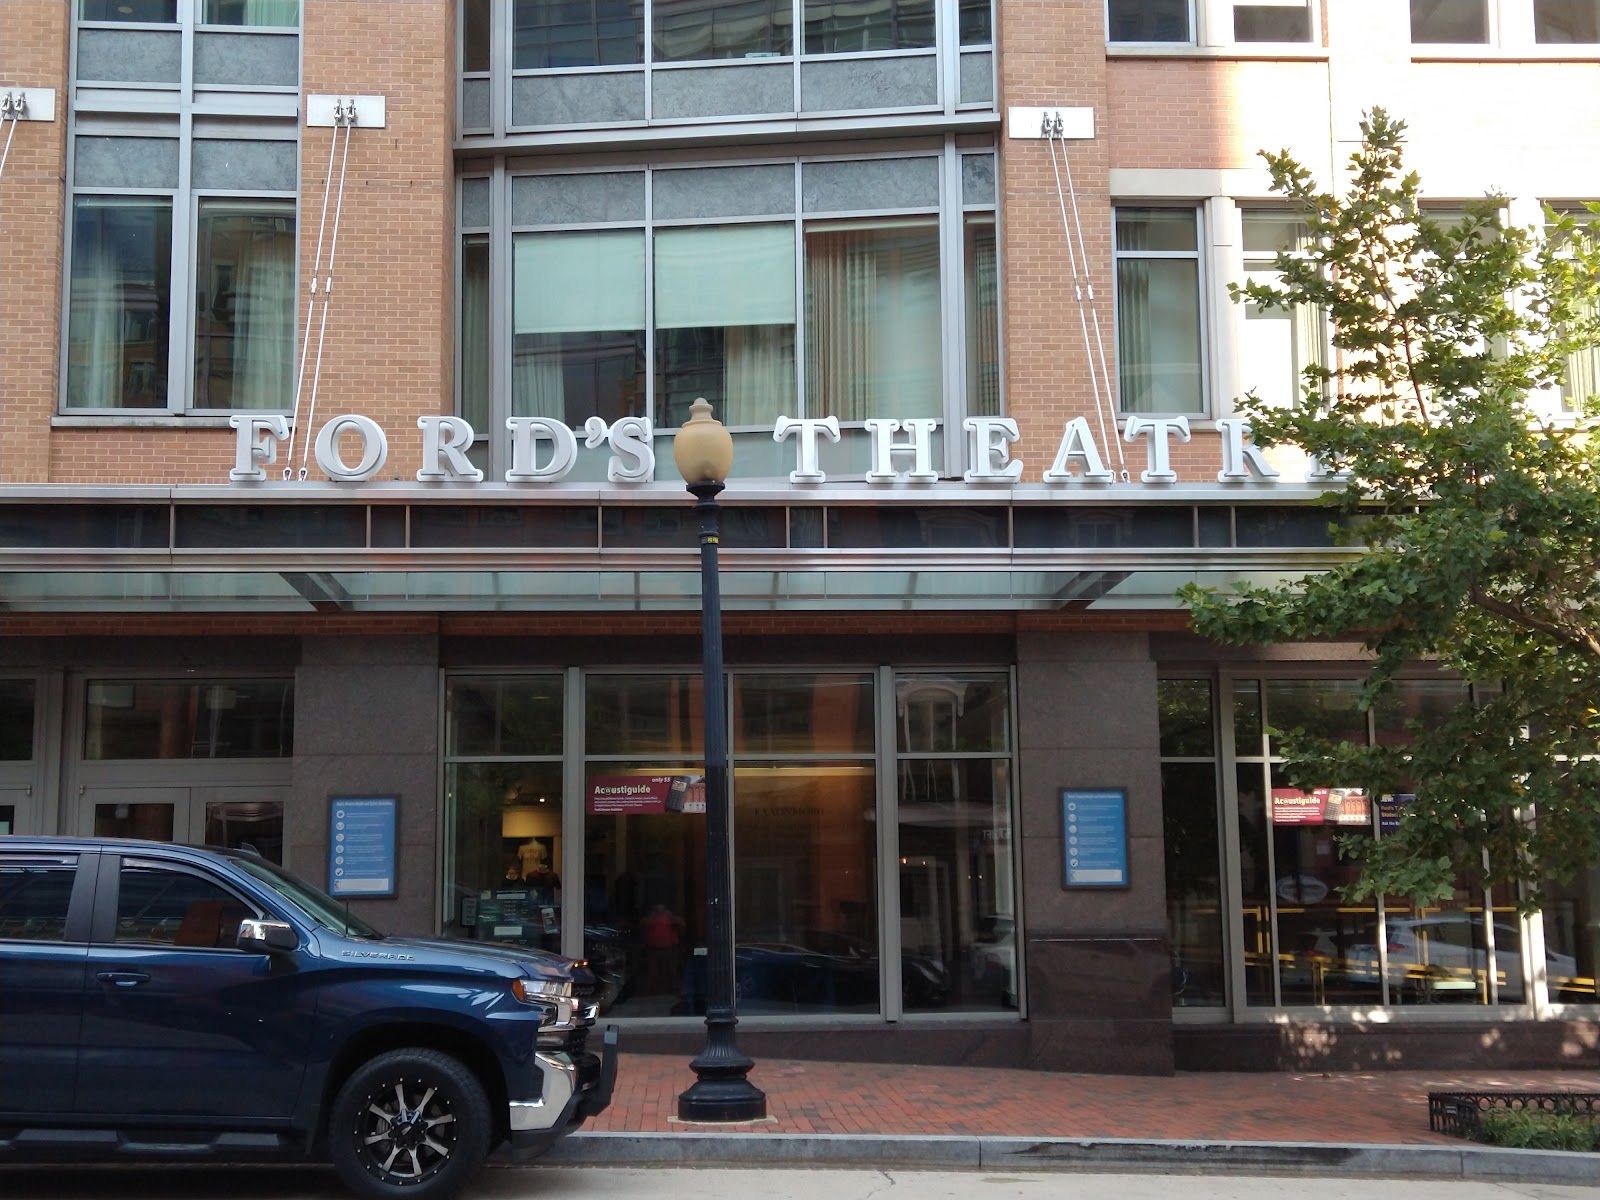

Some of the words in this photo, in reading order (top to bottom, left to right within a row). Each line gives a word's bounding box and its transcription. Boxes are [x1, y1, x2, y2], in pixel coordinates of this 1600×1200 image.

[229, 413, 656, 483] FORD'S
[594, 784, 651, 796] Acoustiguide
[1274, 796, 1321, 806] Acoustiguide
